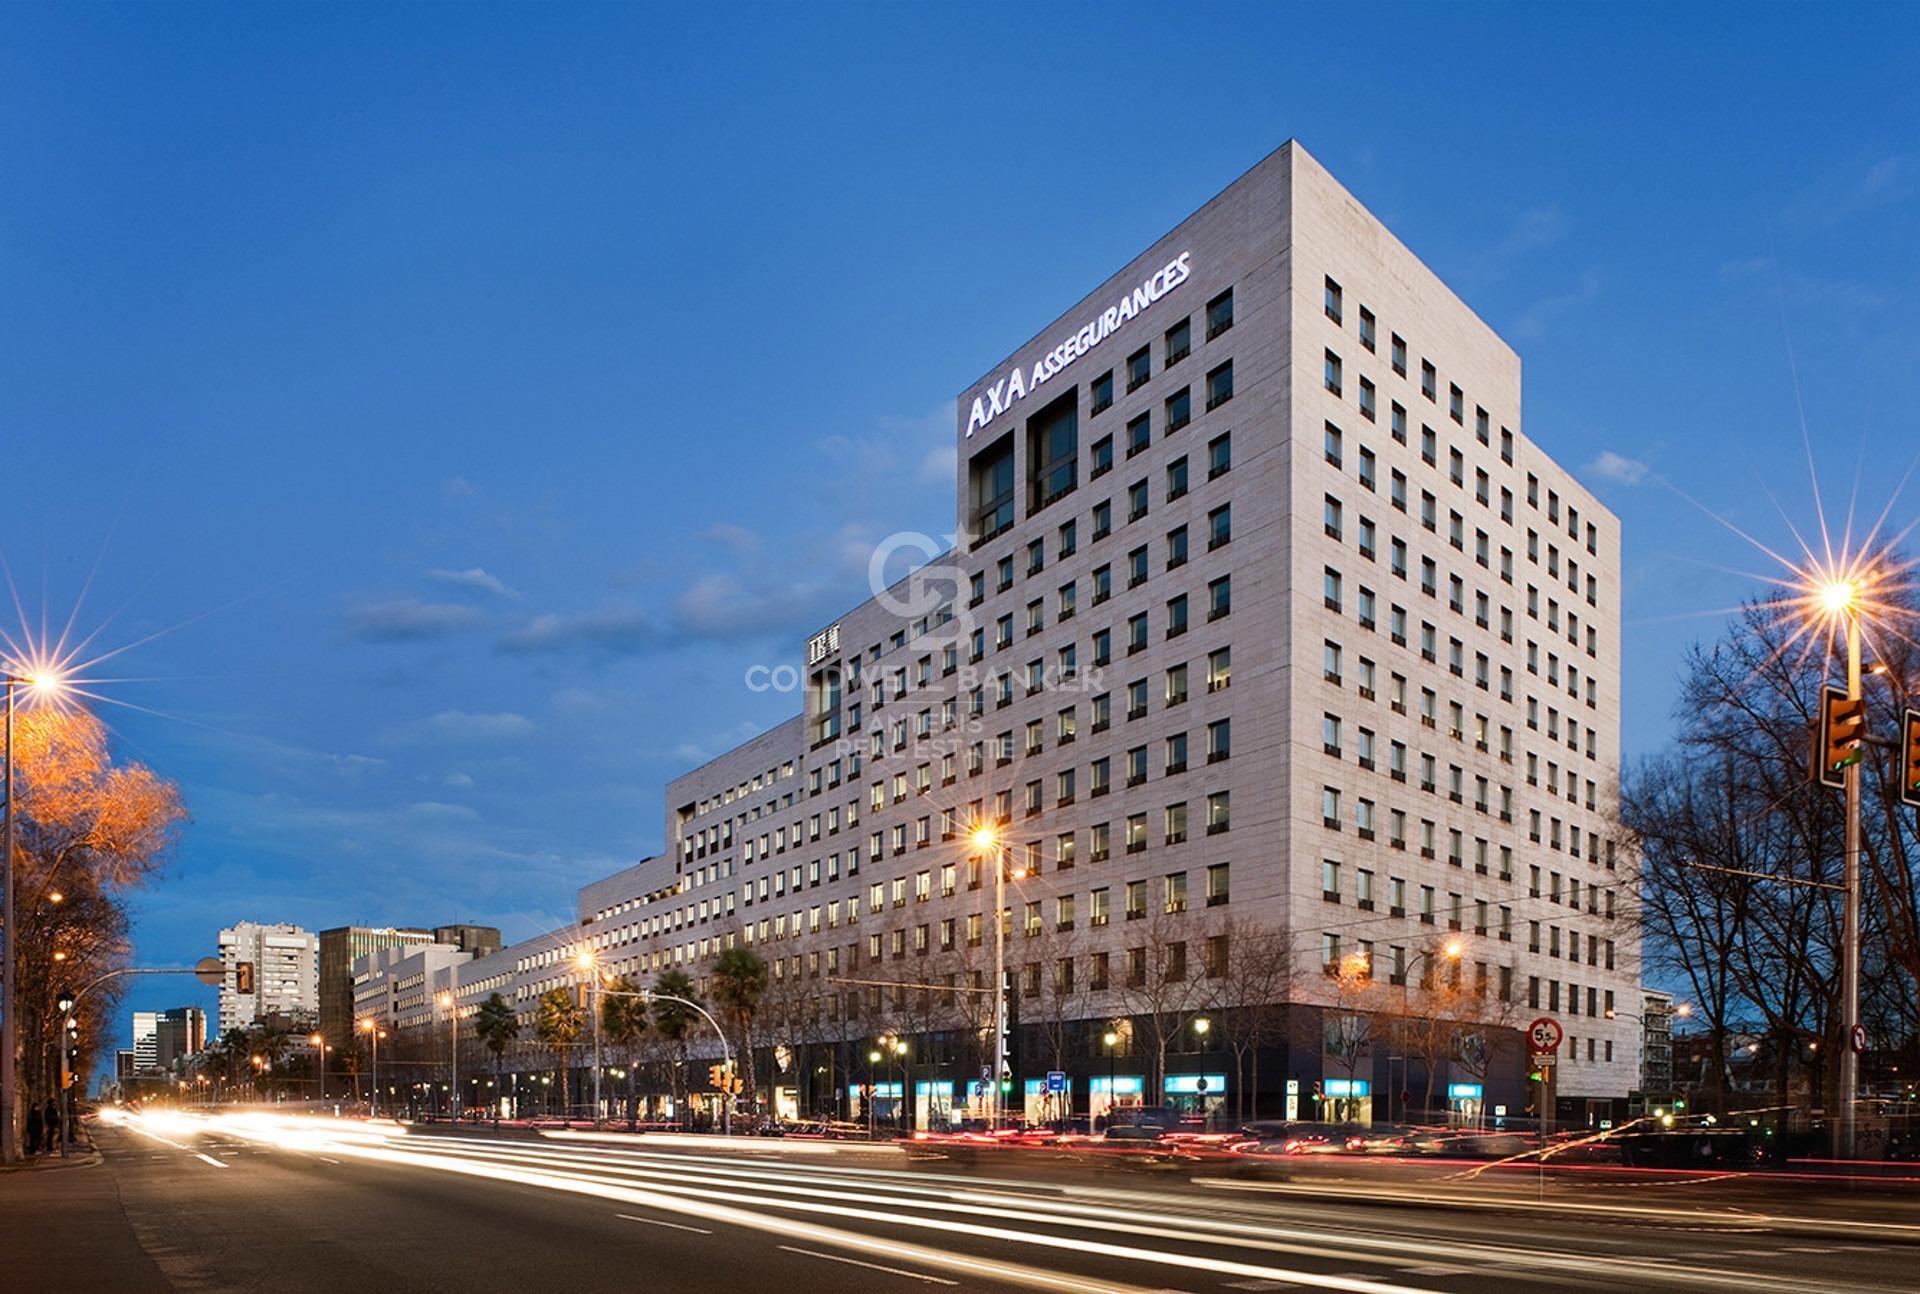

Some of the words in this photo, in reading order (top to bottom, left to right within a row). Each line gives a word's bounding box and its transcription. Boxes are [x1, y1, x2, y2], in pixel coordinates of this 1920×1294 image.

[966, 368, 1026, 438] AXA
[1030, 251, 1191, 391] ASSEGURANCES
[809, 624, 841, 665] IBM
